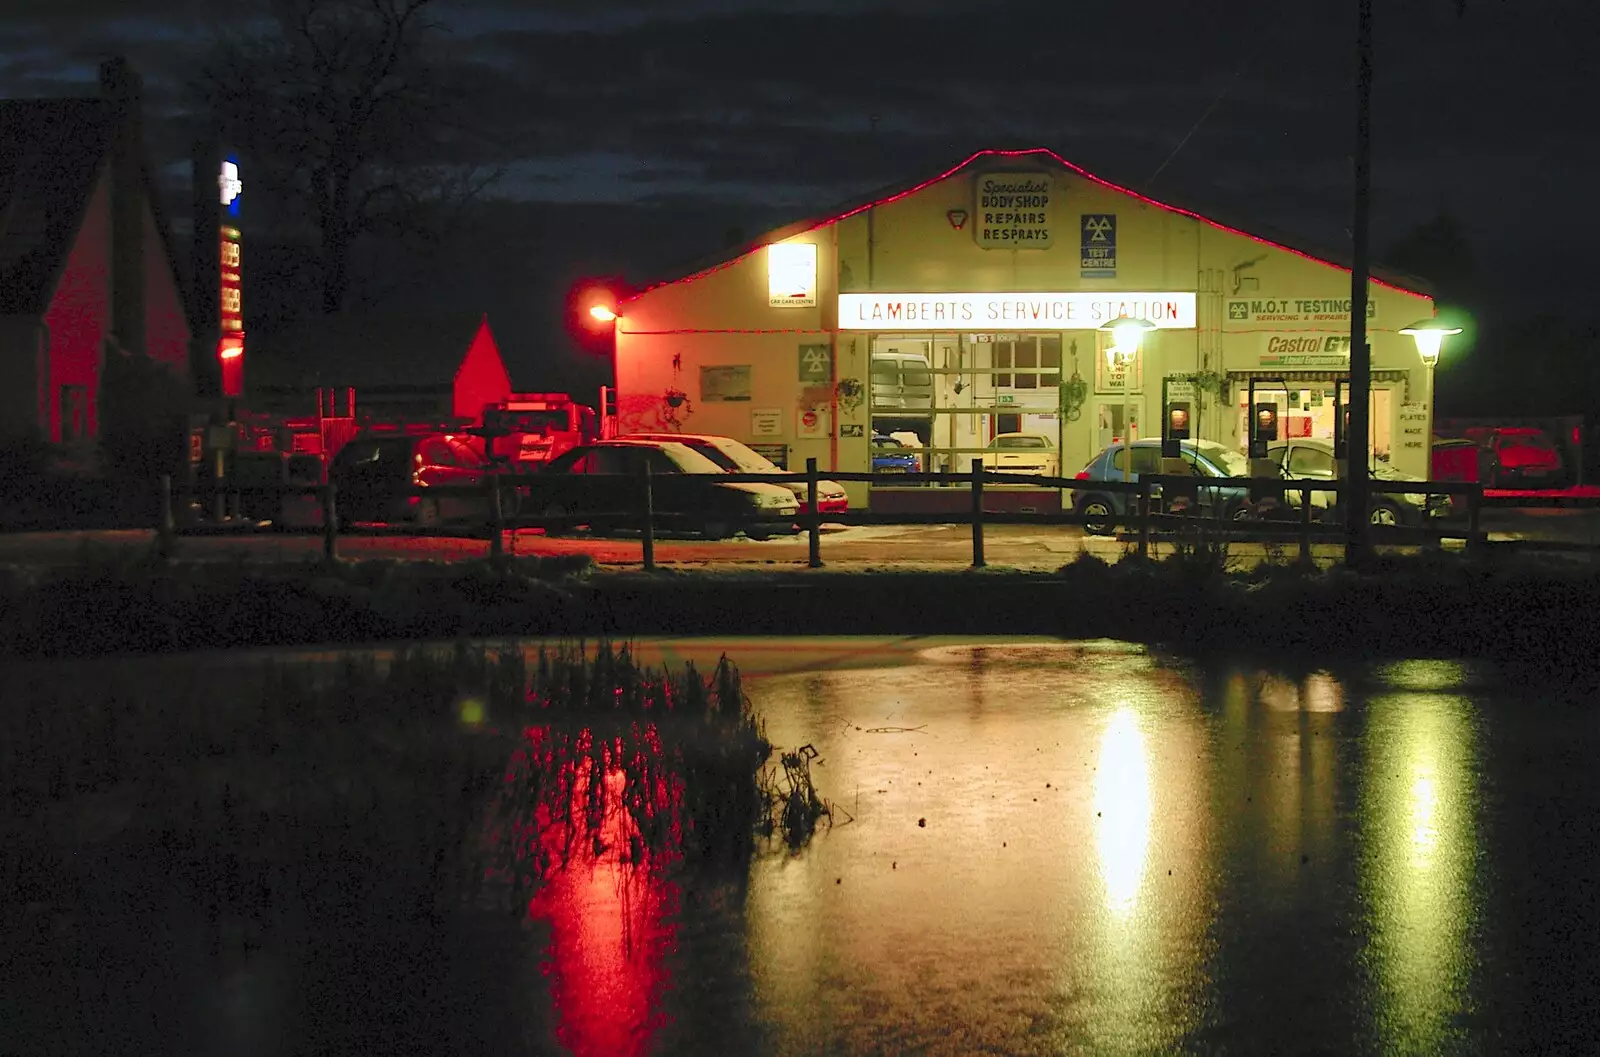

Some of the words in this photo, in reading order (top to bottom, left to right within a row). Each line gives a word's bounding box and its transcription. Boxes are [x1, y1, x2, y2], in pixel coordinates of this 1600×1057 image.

[983, 180, 1048, 195] Specialist
[982, 195, 1049, 208] BODYSHOP
[985, 213, 1046, 224] REPAIRS
[983, 229, 1048, 240] RESPRAYS
[1088, 249, 1109, 258] TEST
[1082, 258, 1115, 267] CENTRE
[859, 302, 973, 321] LAMBERTS
[987, 302, 1078, 320] SERVICE
[1091, 302, 1178, 320] STATION
[1251, 300, 1288, 313] M.O.T
[1295, 300, 1352, 313] TESTING
[1267, 336, 1324, 353] Castrol
[1324, 336, 1351, 352] GT
